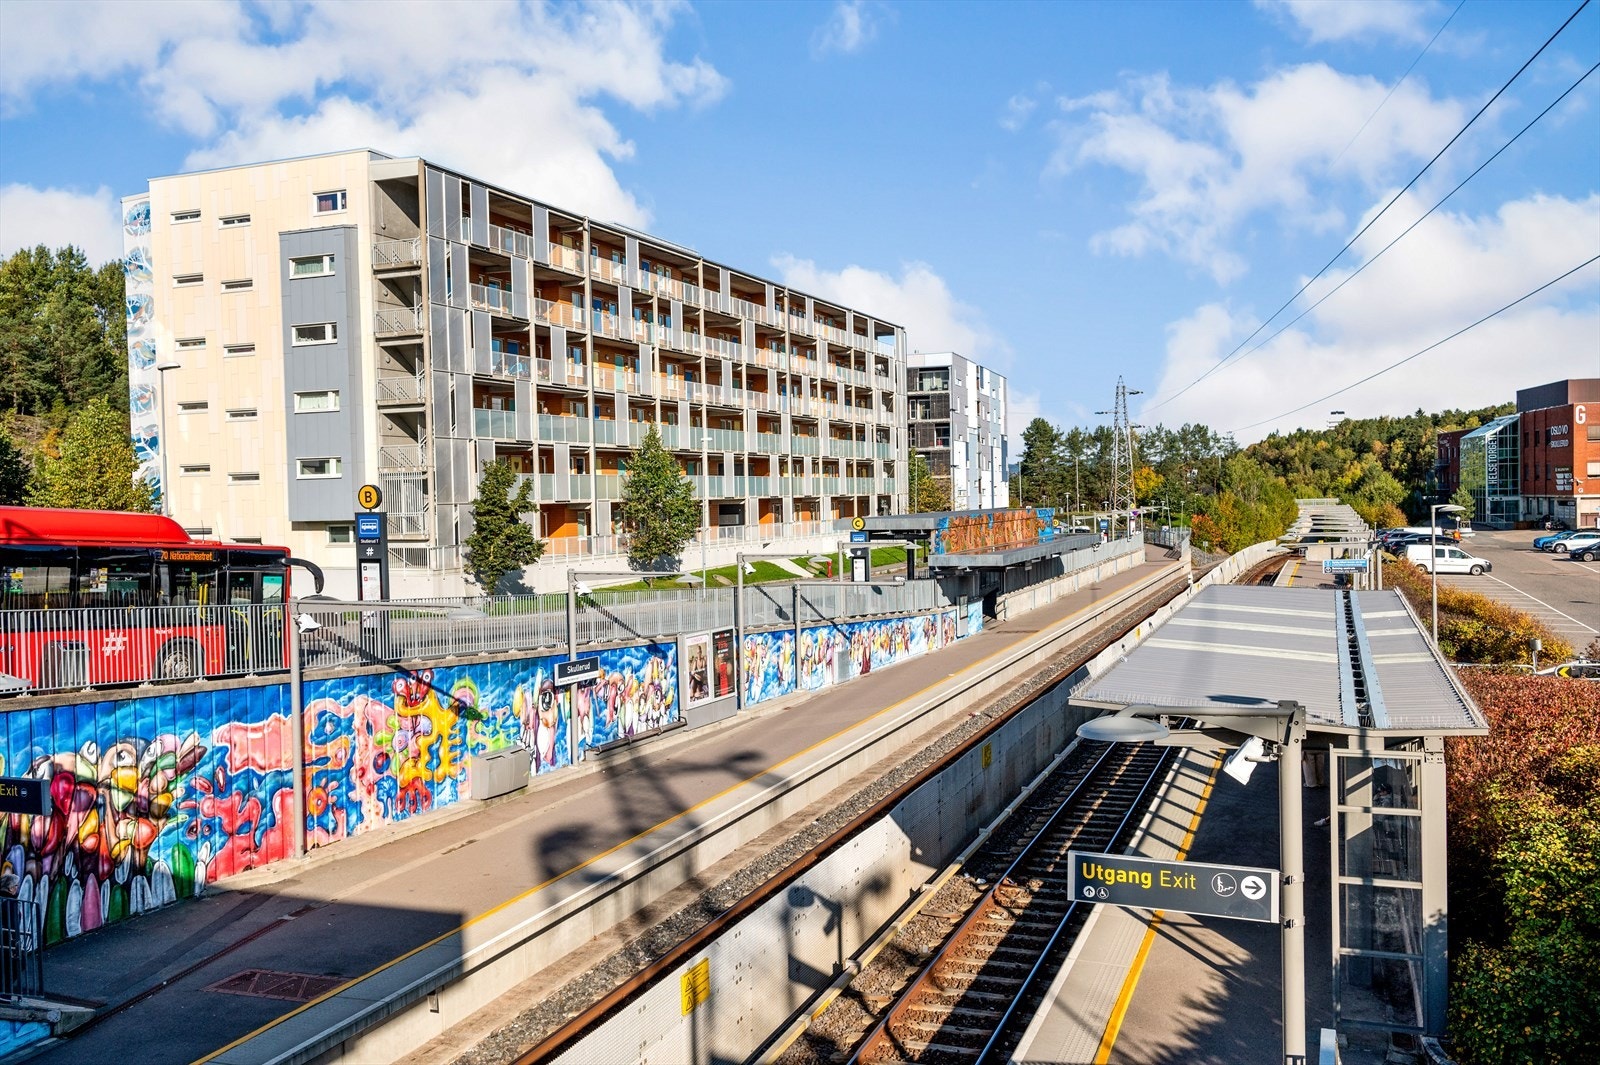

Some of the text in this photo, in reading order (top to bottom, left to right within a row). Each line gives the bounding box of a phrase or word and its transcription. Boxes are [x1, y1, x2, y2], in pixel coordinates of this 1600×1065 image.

[1575, 404, 1586, 425] G
[364, 491, 373, 504] B
[566, 661, 591, 674] Skullerud
[0, 783, 18, 797] Exit
[1082, 862, 1197, 890] Utgang Exit
